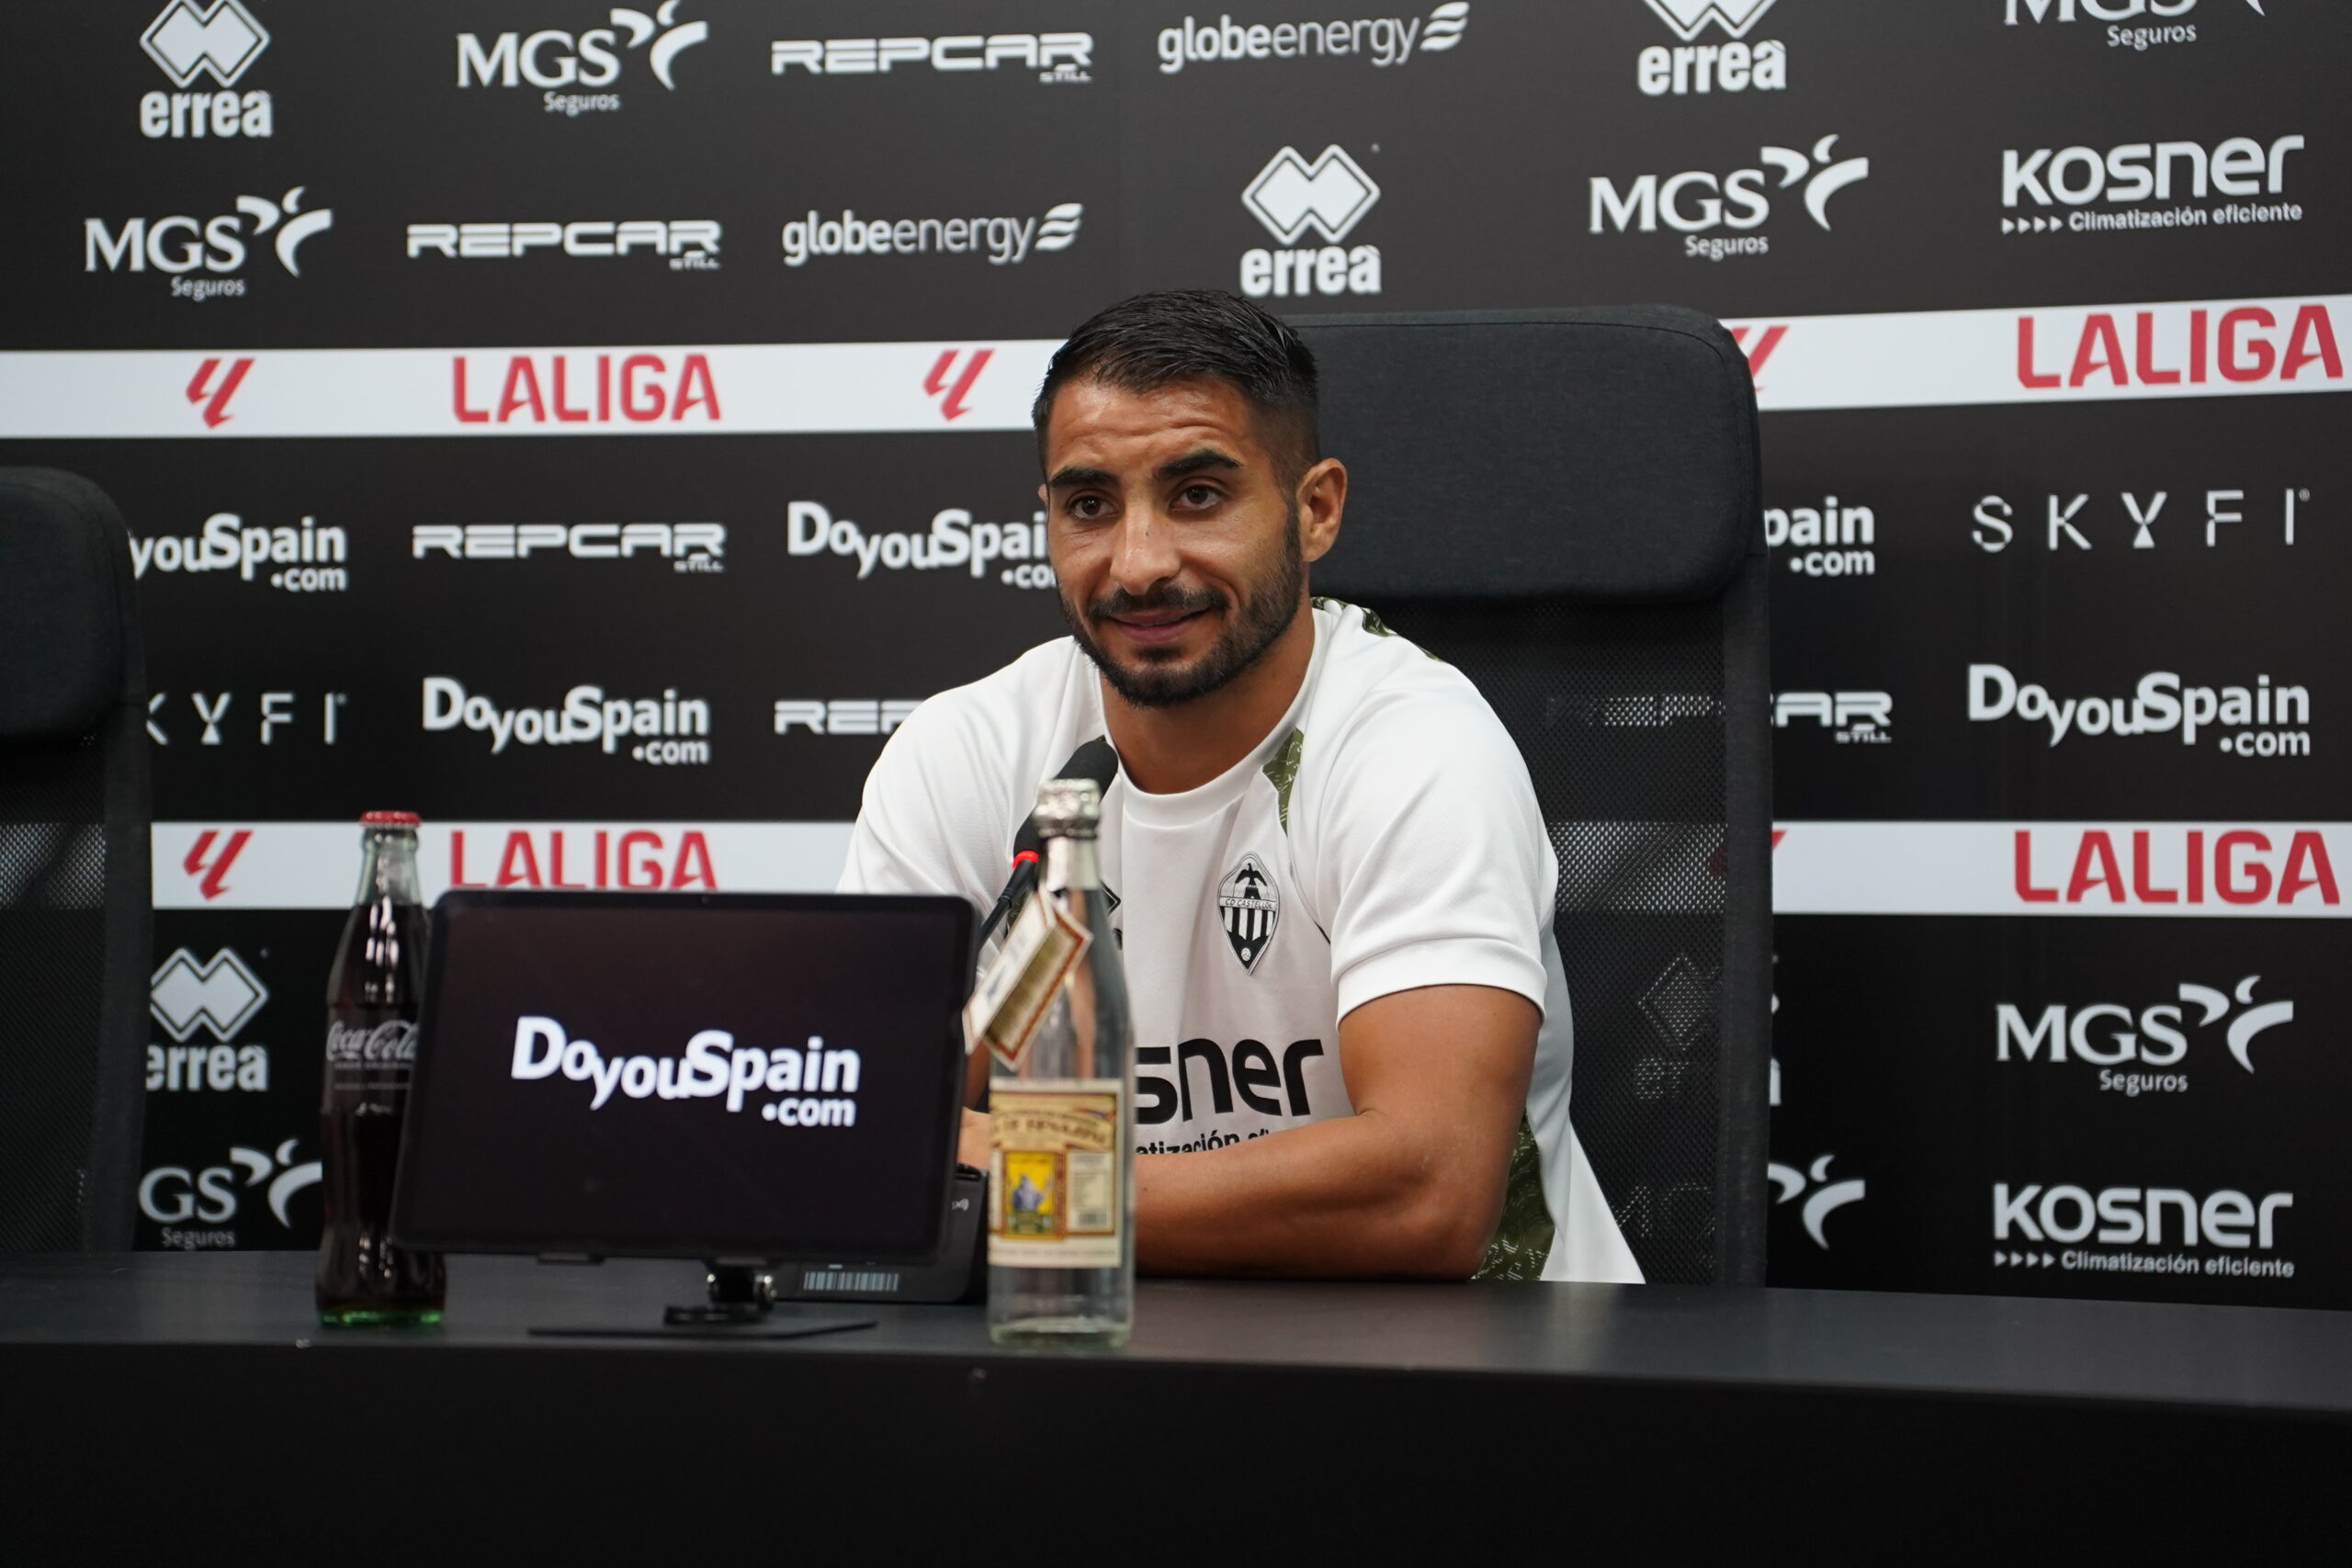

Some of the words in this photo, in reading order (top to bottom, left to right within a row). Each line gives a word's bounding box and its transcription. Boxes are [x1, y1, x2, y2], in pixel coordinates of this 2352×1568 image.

[457, 30, 619, 87] MGS
[772, 33, 1092, 74] REPCAR
[1159, 15, 1422, 73] globeenergy
[2108, 25, 2196, 51] Seguros
[544, 91, 619, 116] Seguros
[1589, 170, 1770, 233] MGS
[2069, 204, 2207, 231] Climatización
[2212, 203, 2302, 224] eficiente
[85, 217, 245, 273] MGS
[407, 221, 722, 257] REPCAR
[783, 209, 1035, 265] globeenergy
[1685, 235, 1769, 260] Seguros
[172, 276, 244, 301] Seguros
[2018, 306, 2342, 388] LALIGA
[454, 355, 720, 423] LALIGA
[128, 513, 347, 580] youSpain
[414, 524, 726, 558] REPCAR
[787, 502, 1047, 579] DoyouSpai
[1791, 551, 1874, 575] .com
[271, 569, 346, 591] .com
[146, 692, 336, 745] KYFI
[424, 677, 709, 753] DoyouSpain
[775, 700, 922, 735] REP
[1968, 664, 2311, 746] DoyouSpain
[633, 741, 708, 764] .com
[2221, 732, 2310, 756] .com
[451, 830, 717, 889] LALIGA
[2015, 830, 2339, 904] LALIGA
[1996, 1004, 2189, 1065] MGS
[512, 1016, 861, 1112] DoyouSpain
[1136, 1039, 1324, 1124] sner
[2100, 1069, 2188, 1096] Seguros
[762, 1098, 856, 1127] .com
[139, 1167, 237, 1224] GS
[162, 1227, 235, 1250] Seguros
[2062, 1250, 2199, 1273] Climatización
[2205, 1256, 2294, 1277] eficiente
